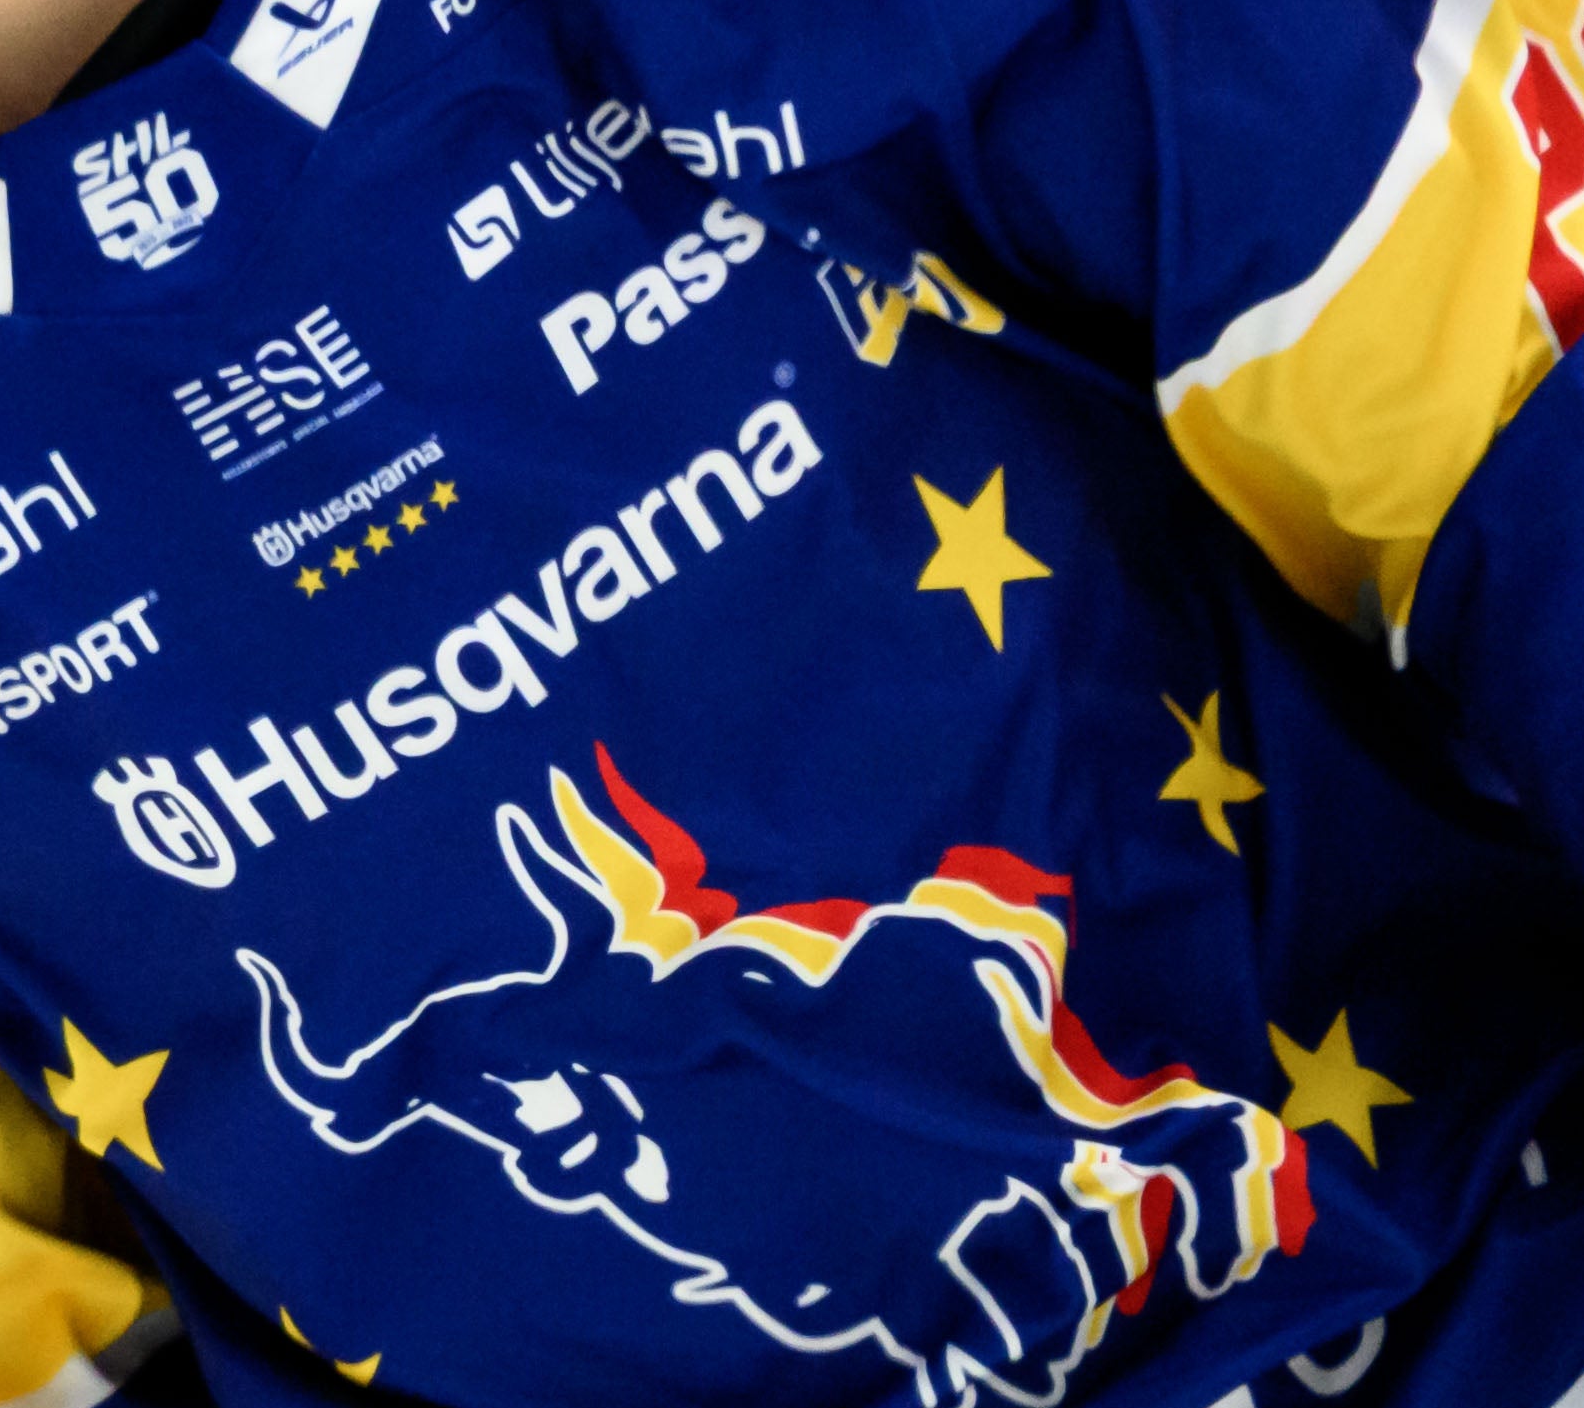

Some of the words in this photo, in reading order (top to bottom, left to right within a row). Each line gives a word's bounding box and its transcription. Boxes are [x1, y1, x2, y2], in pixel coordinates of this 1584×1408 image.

[73, 111, 191, 197] SHL
[80, 148, 220, 262] 50
[510, 99, 806, 218] Liljeahl
[285, 439, 445, 547] Husqvarna
[195, 398, 825, 849] Husqvarna
